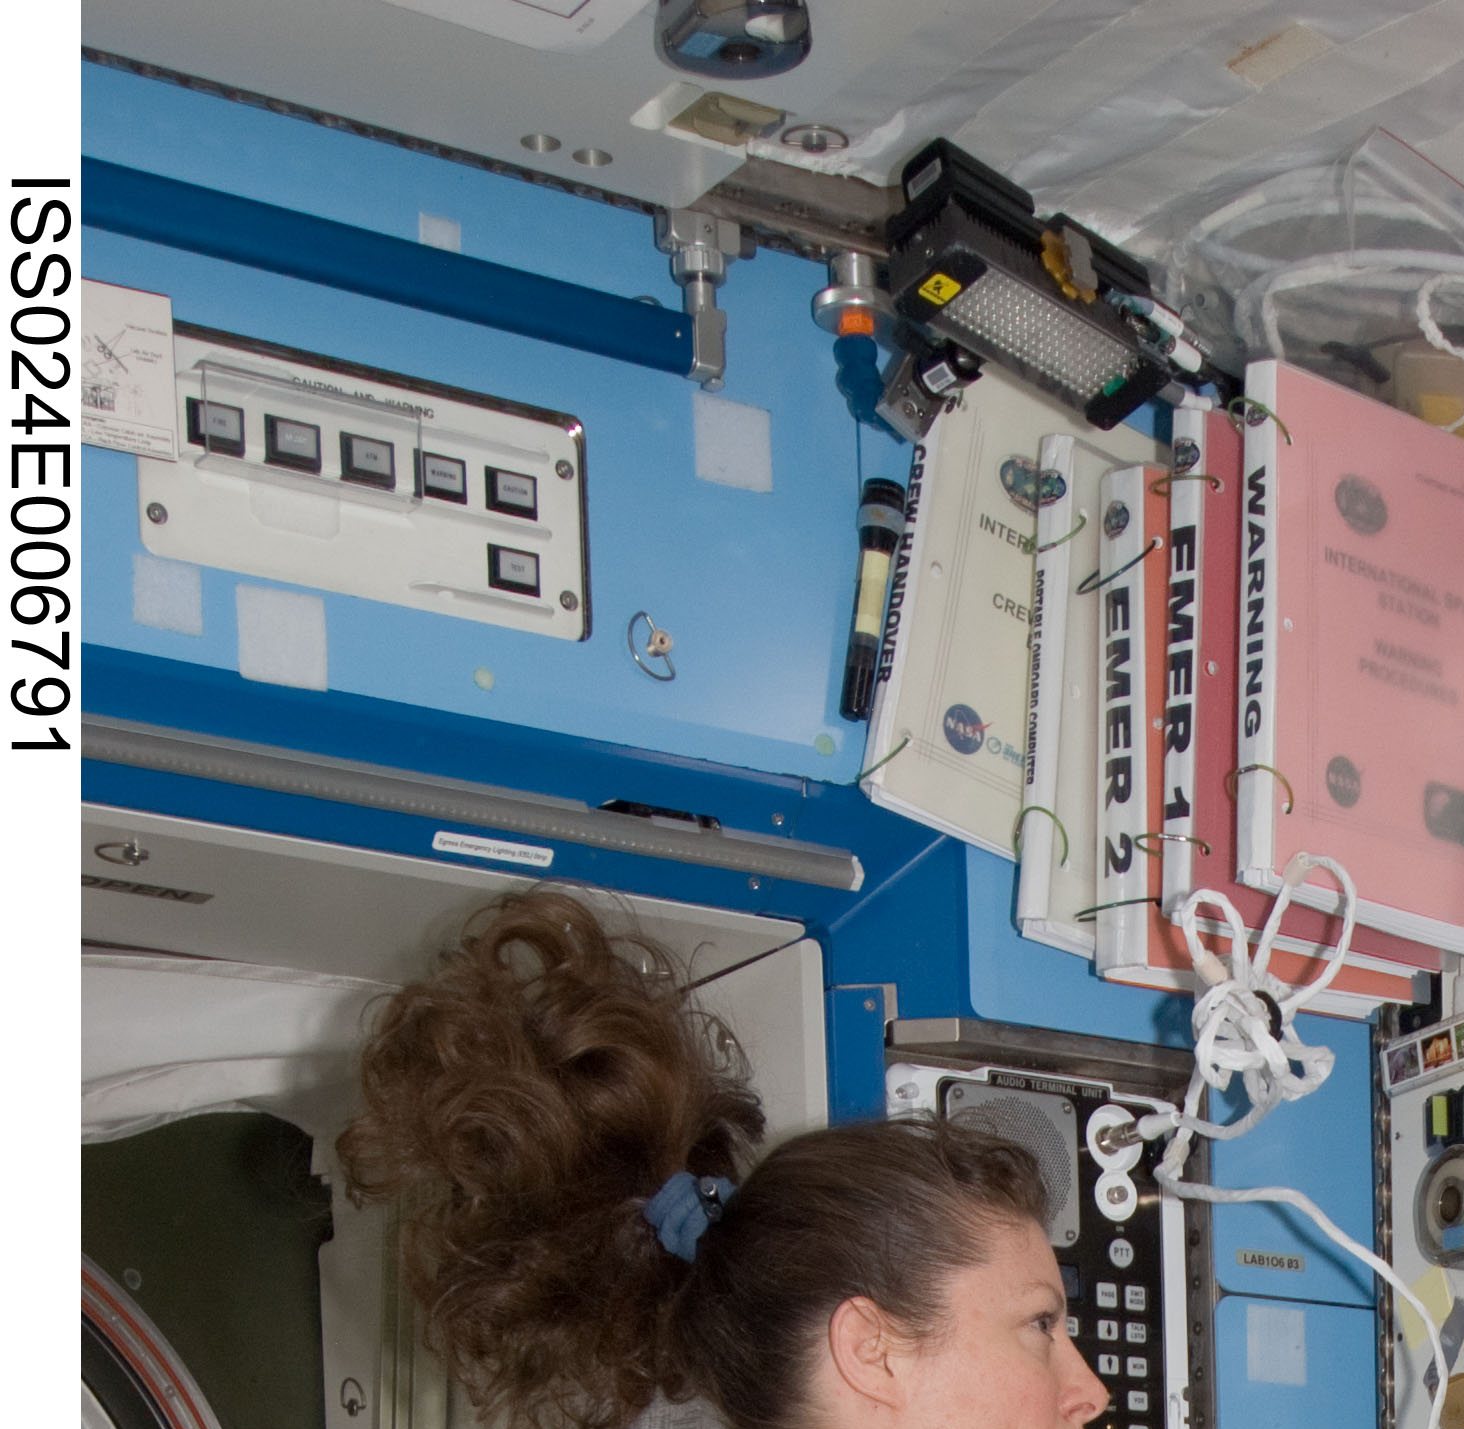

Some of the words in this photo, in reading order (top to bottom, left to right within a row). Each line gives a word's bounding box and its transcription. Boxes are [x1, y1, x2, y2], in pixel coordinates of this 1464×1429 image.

[292, 376, 343, 395] CAUTION
[353, 389, 376, 402] AND
[385, 396, 434, 419] WARNING
[502, 483, 529, 497] CAUTION
[903, 444, 926, 525] CREW
[510, 563, 525, 574] TEST
[1324, 545, 1440, 603] INTERNATIONAL
[876, 530, 914, 683] HANDOVER
[1242, 463, 1268, 740] WARNING
[1377, 592, 1441, 629] STATION
[1163, 524, 1198, 756] EMER
[1375, 637, 1443, 678] WARNING
[1104, 586, 1133, 813] EMER
[1358, 657, 1459, 705] PROCEDURES
[1165, 790, 1191, 820] 1
[1104, 832, 1132, 880] 2
[996, 1075, 1026, 1089] AUDIO
[1031, 1079, 1077, 1096] TERMINAL
[1081, 1087, 1104, 1099] UNIT
[1113, 1246, 1130, 1258] PTT
